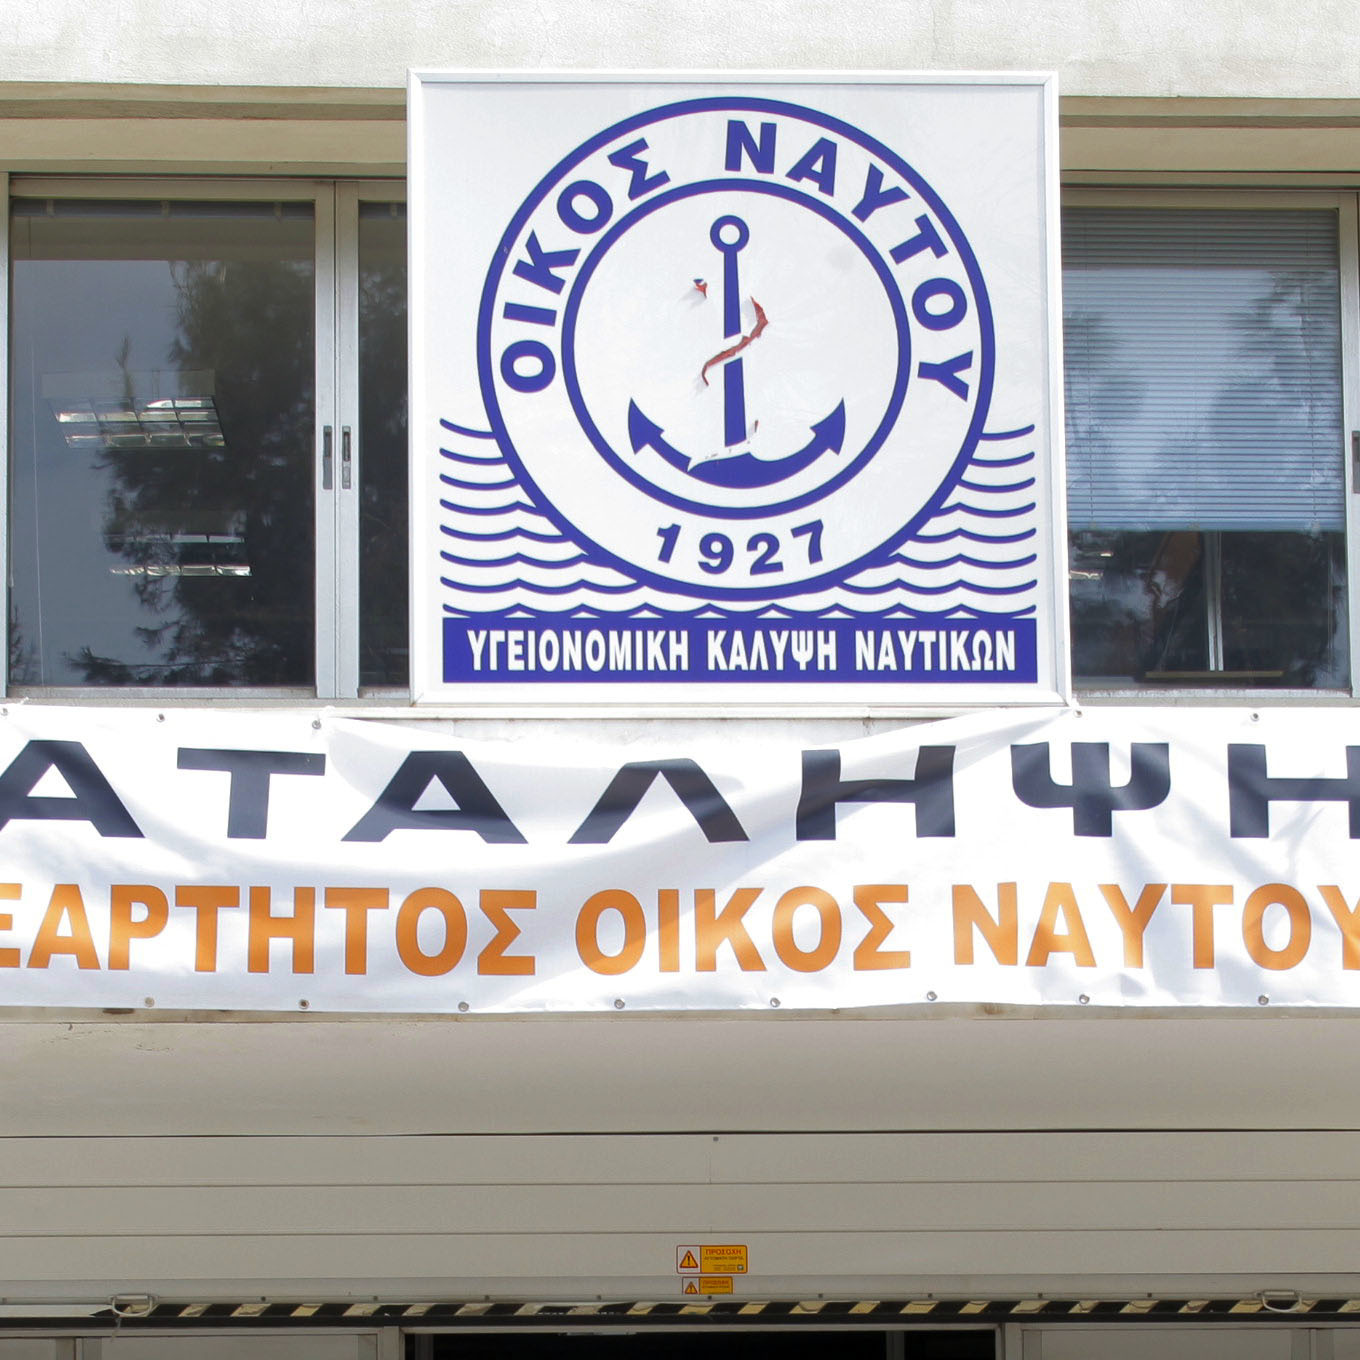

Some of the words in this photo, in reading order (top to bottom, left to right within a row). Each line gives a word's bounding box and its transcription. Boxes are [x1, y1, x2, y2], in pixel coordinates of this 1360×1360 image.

[500, 137, 671, 393] ΟΙΚΟΣ
[724, 119, 974, 401] ΝΑΥΤΟΥ
[656, 518, 825, 577] 1927
[466, 629, 689, 672] ΥΓΕΙΟΝΟΜΙΚΗ
[706, 629, 837, 672] ΚΑΛΥΨΗ
[854, 629, 1015, 672] ΝΑΥΤΙΚΩΝ
[574, 885, 912, 976] ΟΙΚΟΣ
